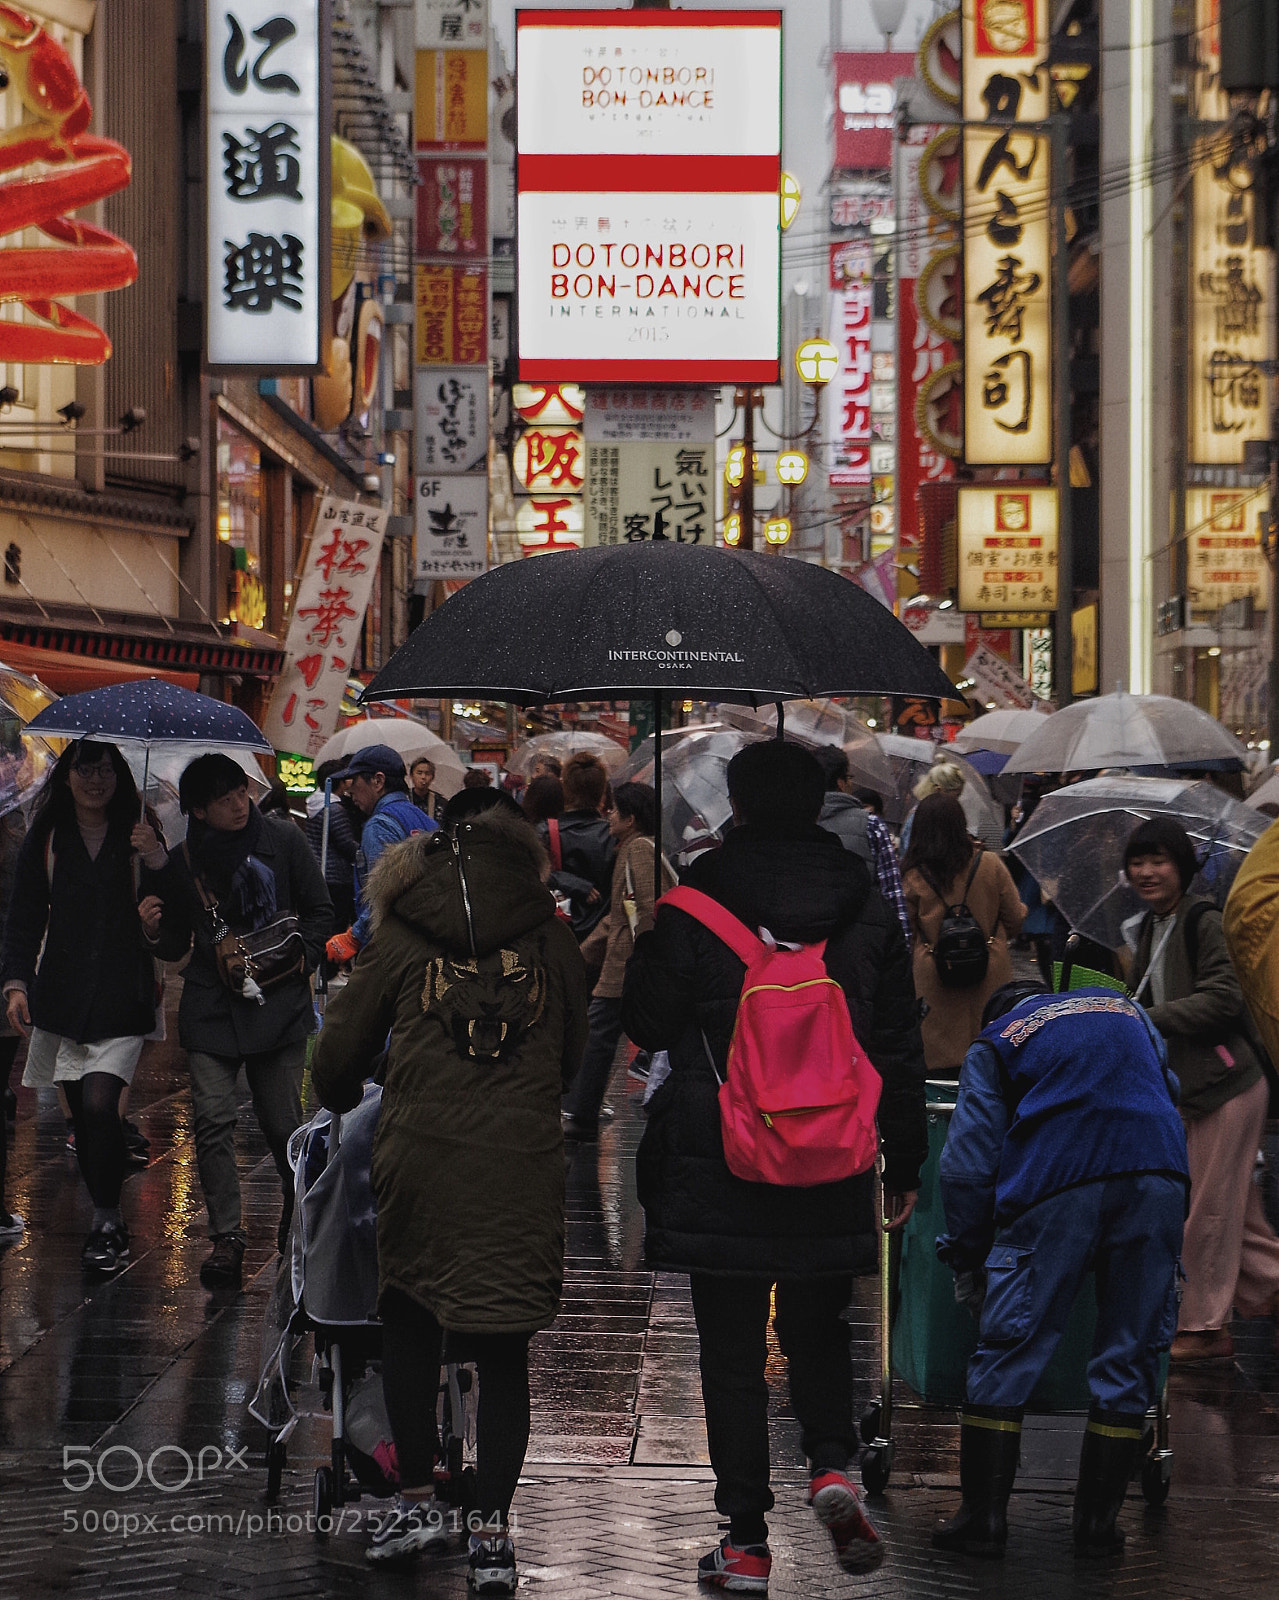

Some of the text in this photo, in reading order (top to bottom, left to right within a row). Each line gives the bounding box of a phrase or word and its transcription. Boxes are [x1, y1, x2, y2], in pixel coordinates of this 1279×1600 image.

[582, 66, 716, 86] DOTONBORI
[552, 243, 744, 269] DOTONBORI
[551, 273, 745, 299] BON-DANCE
[550, 304, 746, 319] INTERNATIONAL
[420, 482, 441, 498] 6F
[282, 527, 370, 733] 松葉かに
[658, 662, 693, 670] OSAKA
